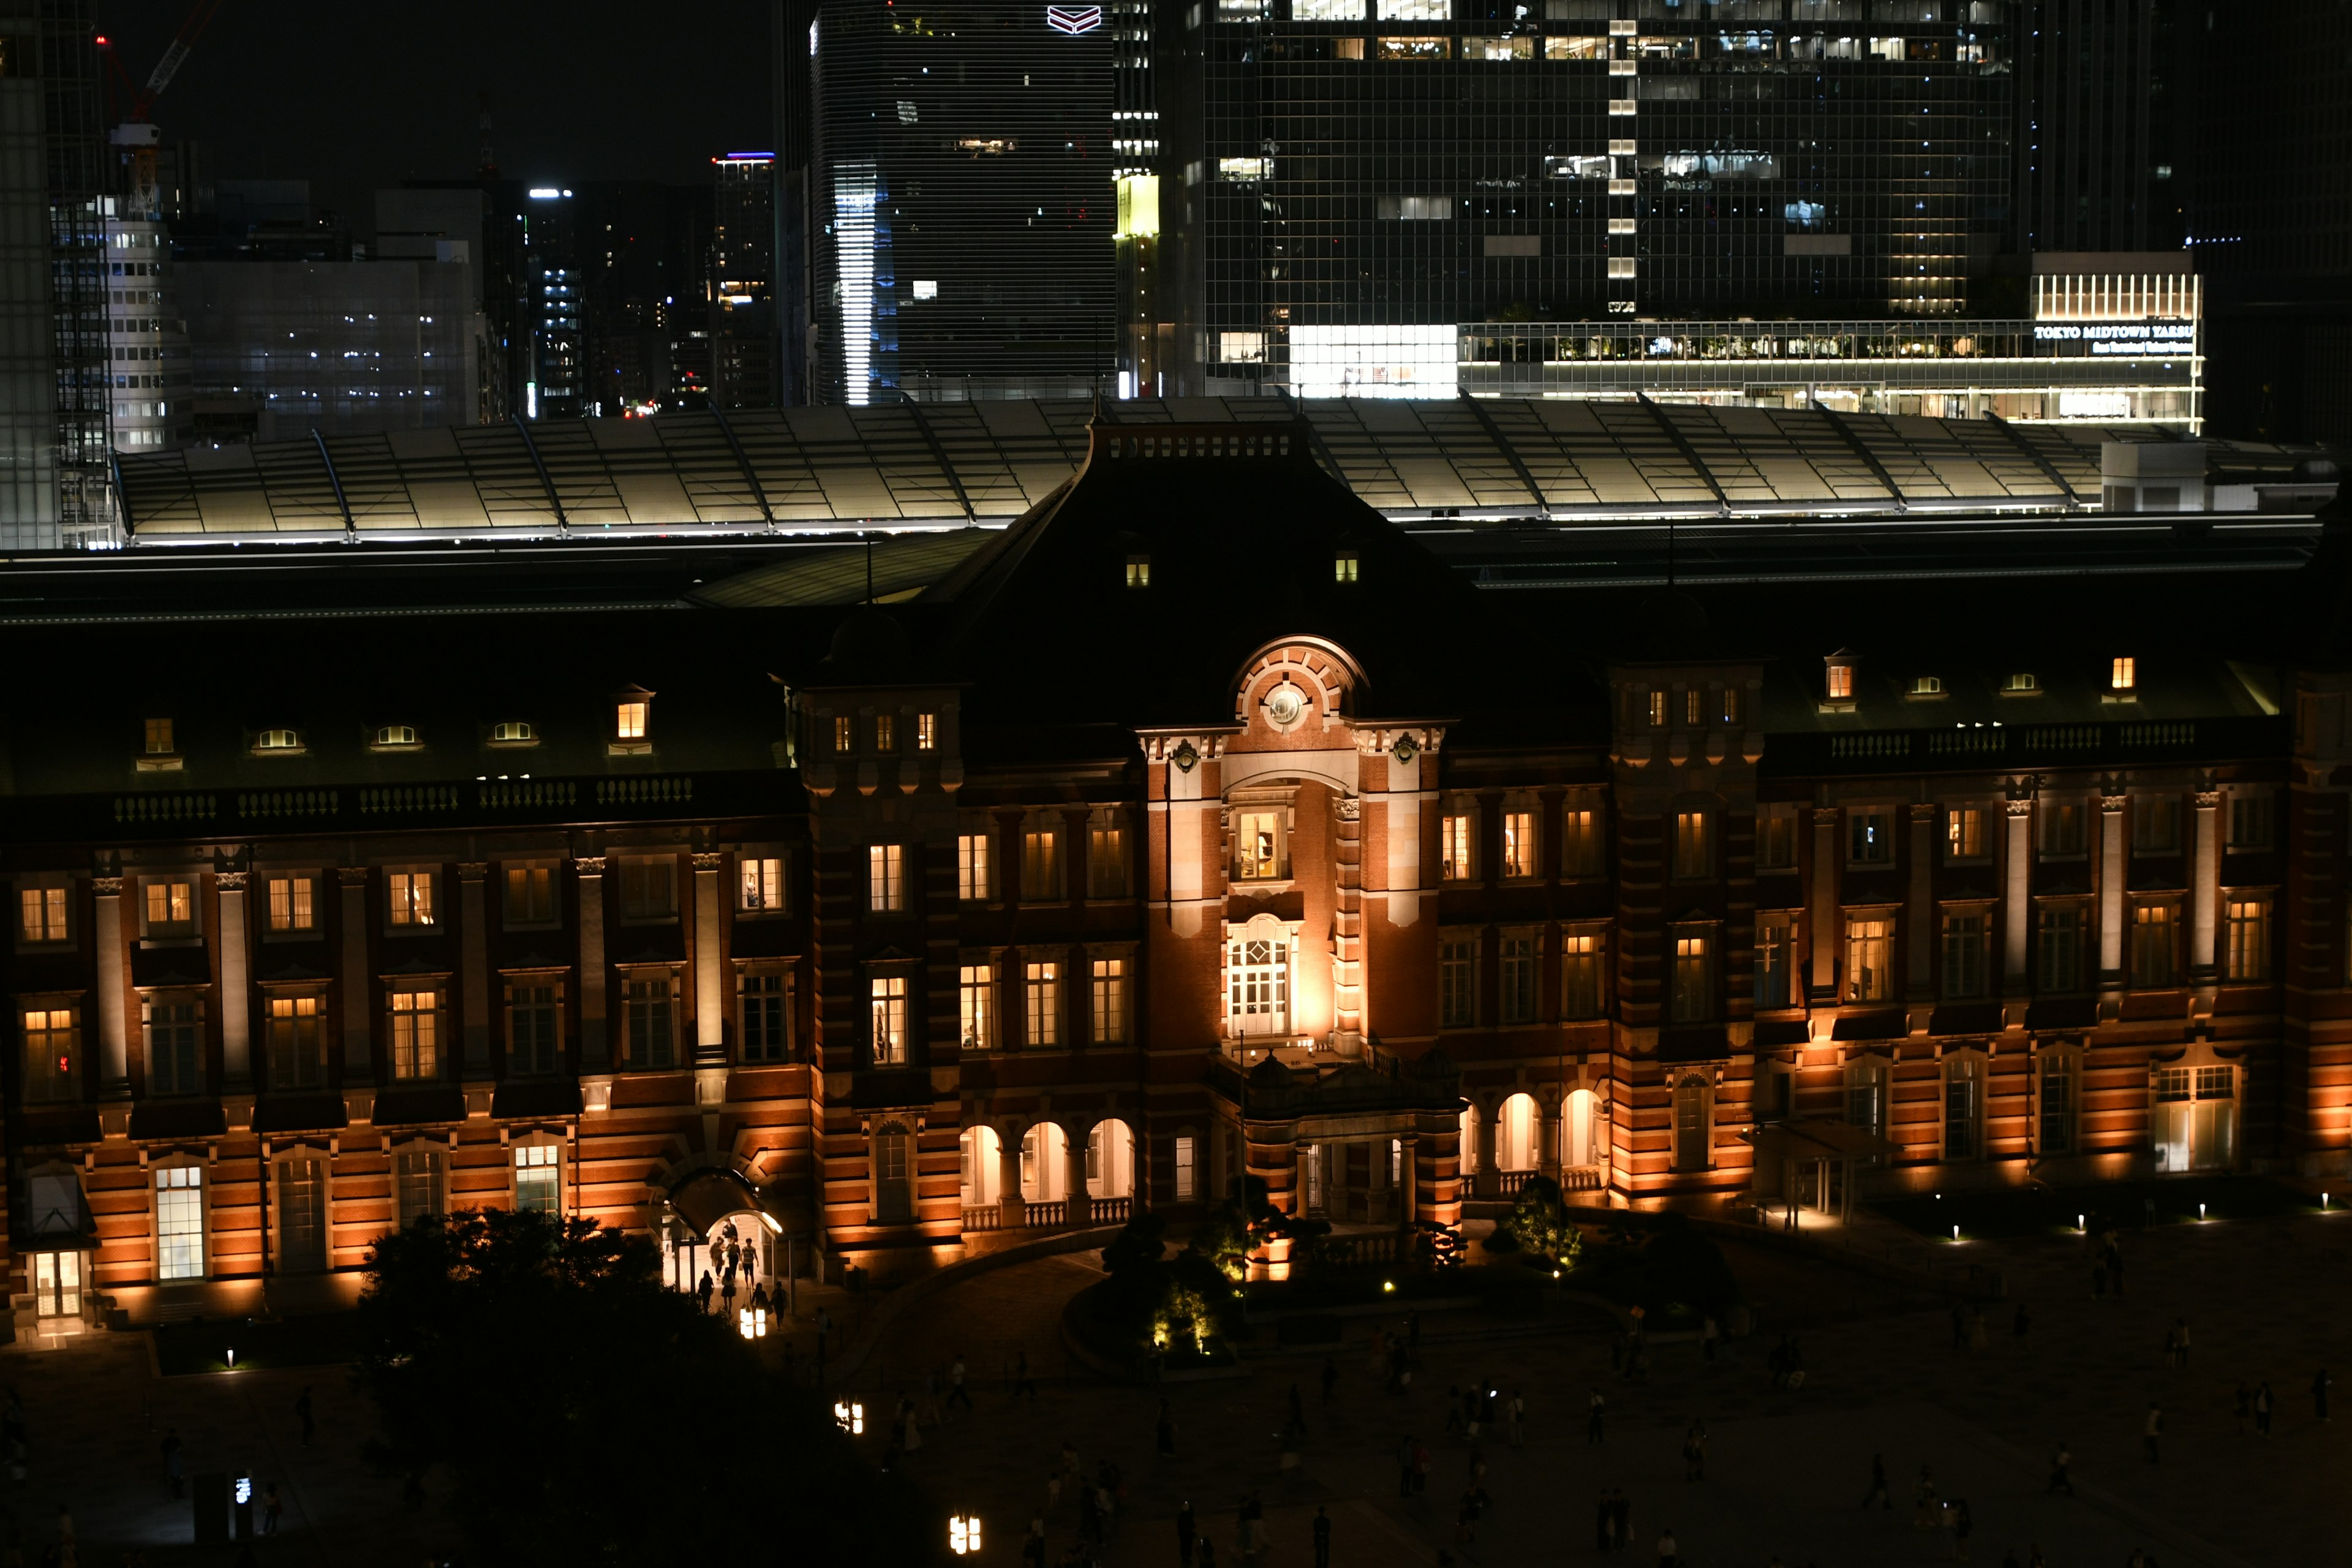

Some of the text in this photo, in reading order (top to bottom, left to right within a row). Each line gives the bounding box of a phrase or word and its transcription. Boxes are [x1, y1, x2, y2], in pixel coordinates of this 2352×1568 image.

[2034, 325, 2193, 339] TOKYO MIDTOWN YAESU
